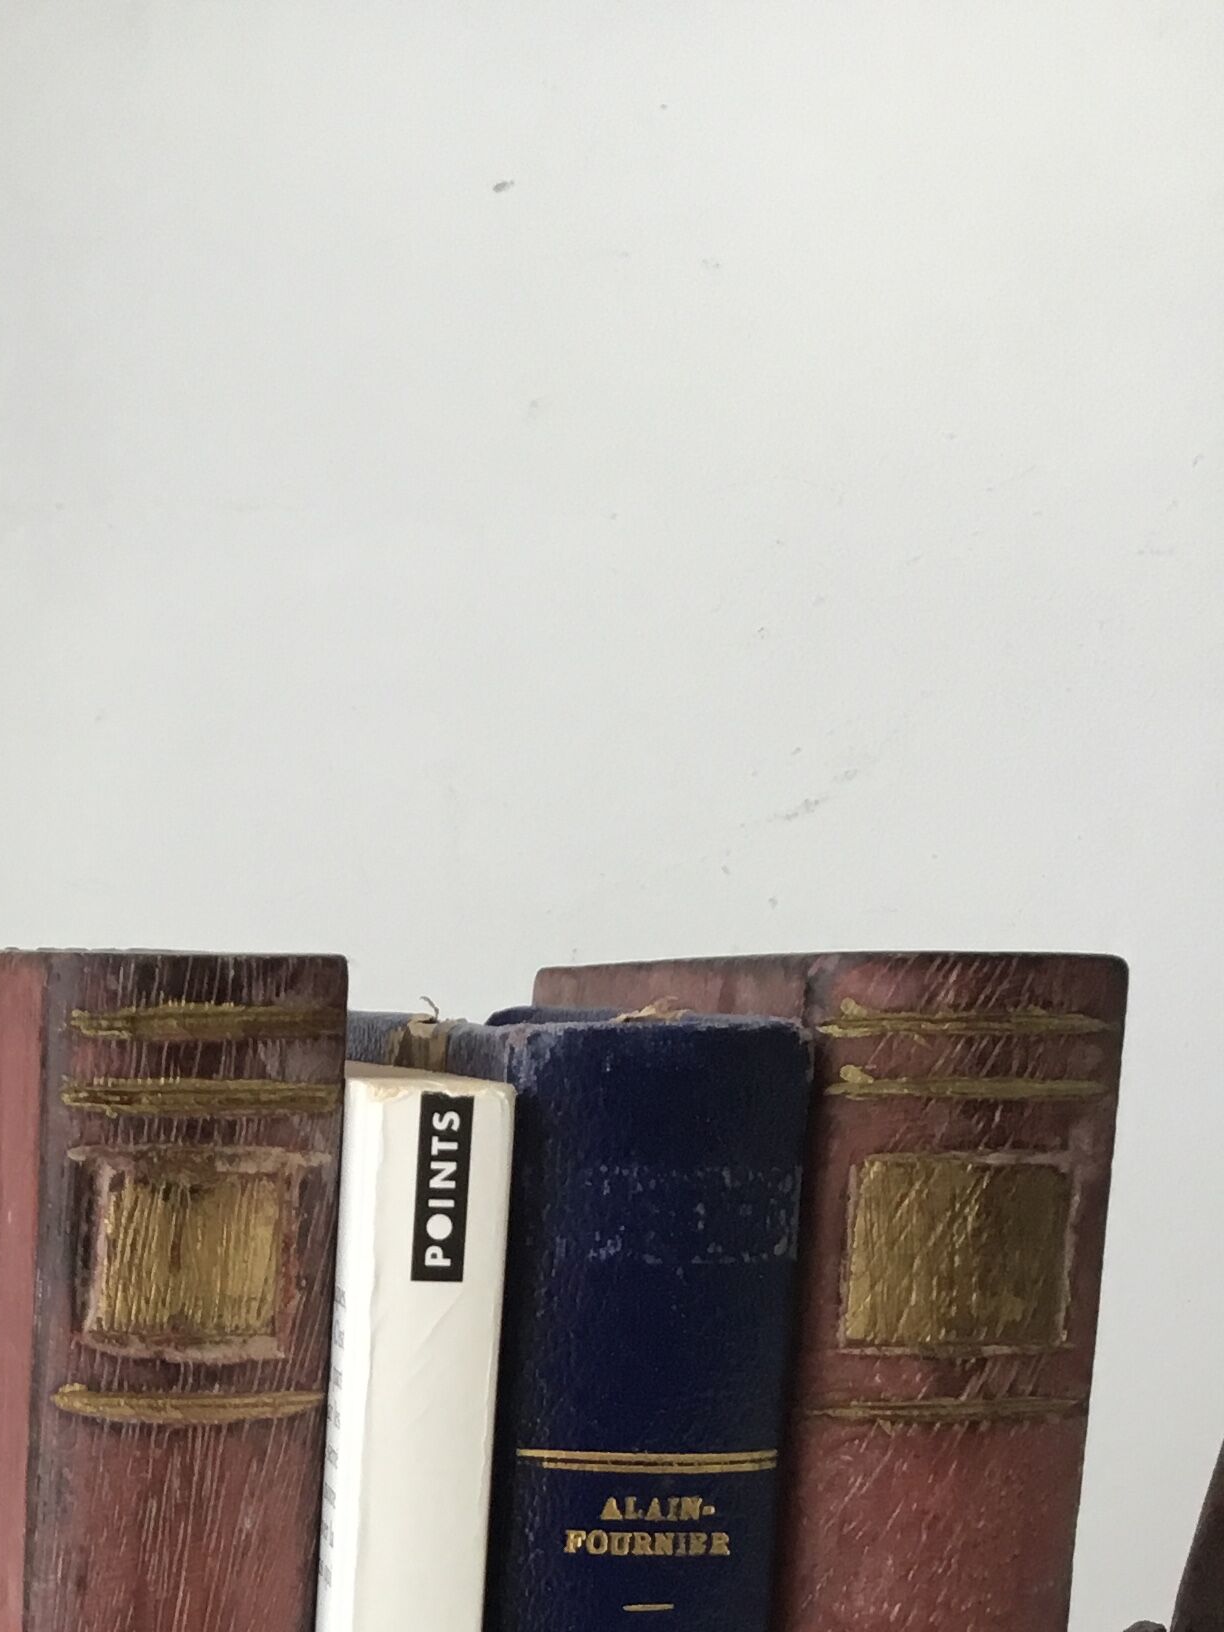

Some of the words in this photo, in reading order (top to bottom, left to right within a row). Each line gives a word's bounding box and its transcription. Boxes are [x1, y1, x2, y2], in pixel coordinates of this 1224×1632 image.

[424, 1109, 461, 1268] POINTS
[599, 1495, 716, 1522] ALAIN-
[563, 1528, 731, 1556] FOURNIER
